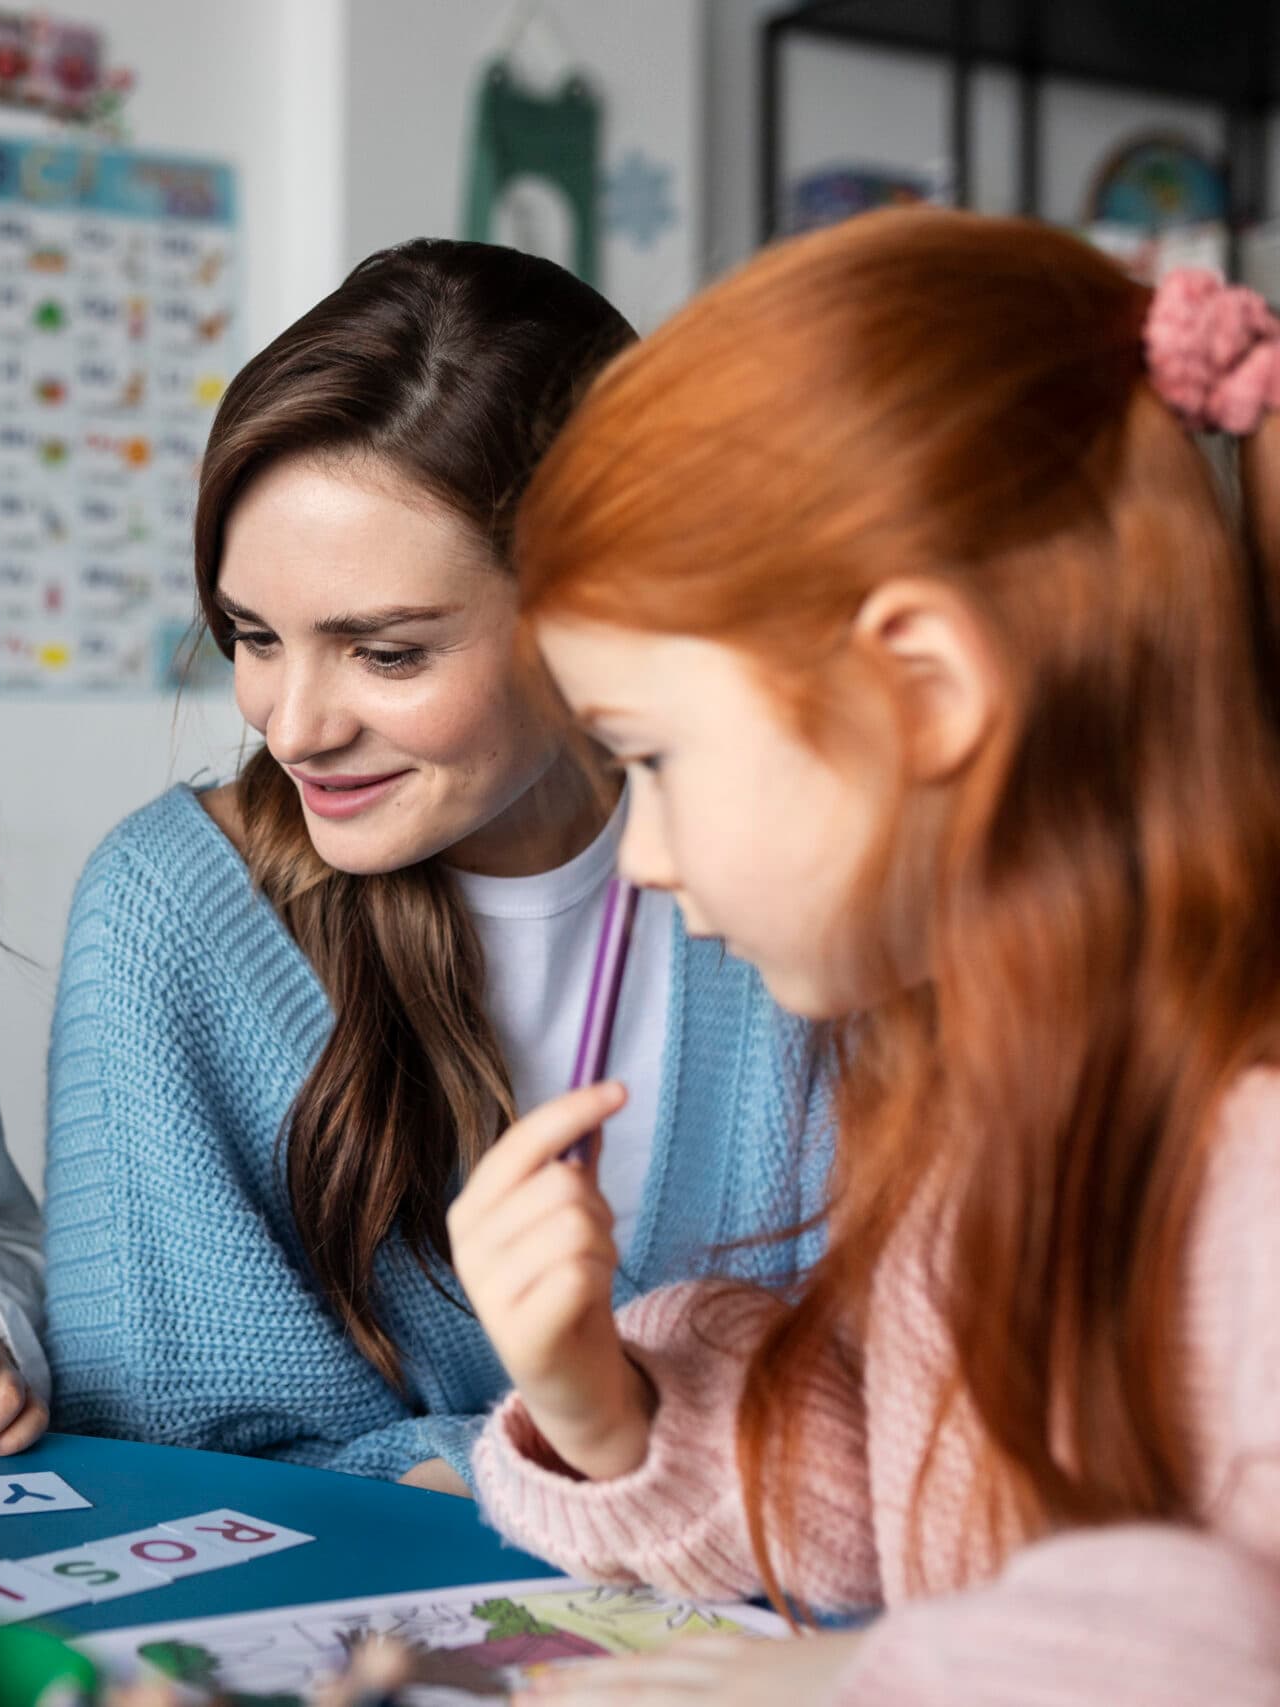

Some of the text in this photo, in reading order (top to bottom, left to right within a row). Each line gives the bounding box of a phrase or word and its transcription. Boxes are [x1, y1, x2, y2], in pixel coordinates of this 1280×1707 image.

[3, 1483, 56, 1504] Y
[194, 1519, 276, 1543] R
[130, 1540, 197, 1563] O
[53, 1561, 120, 1586] S
